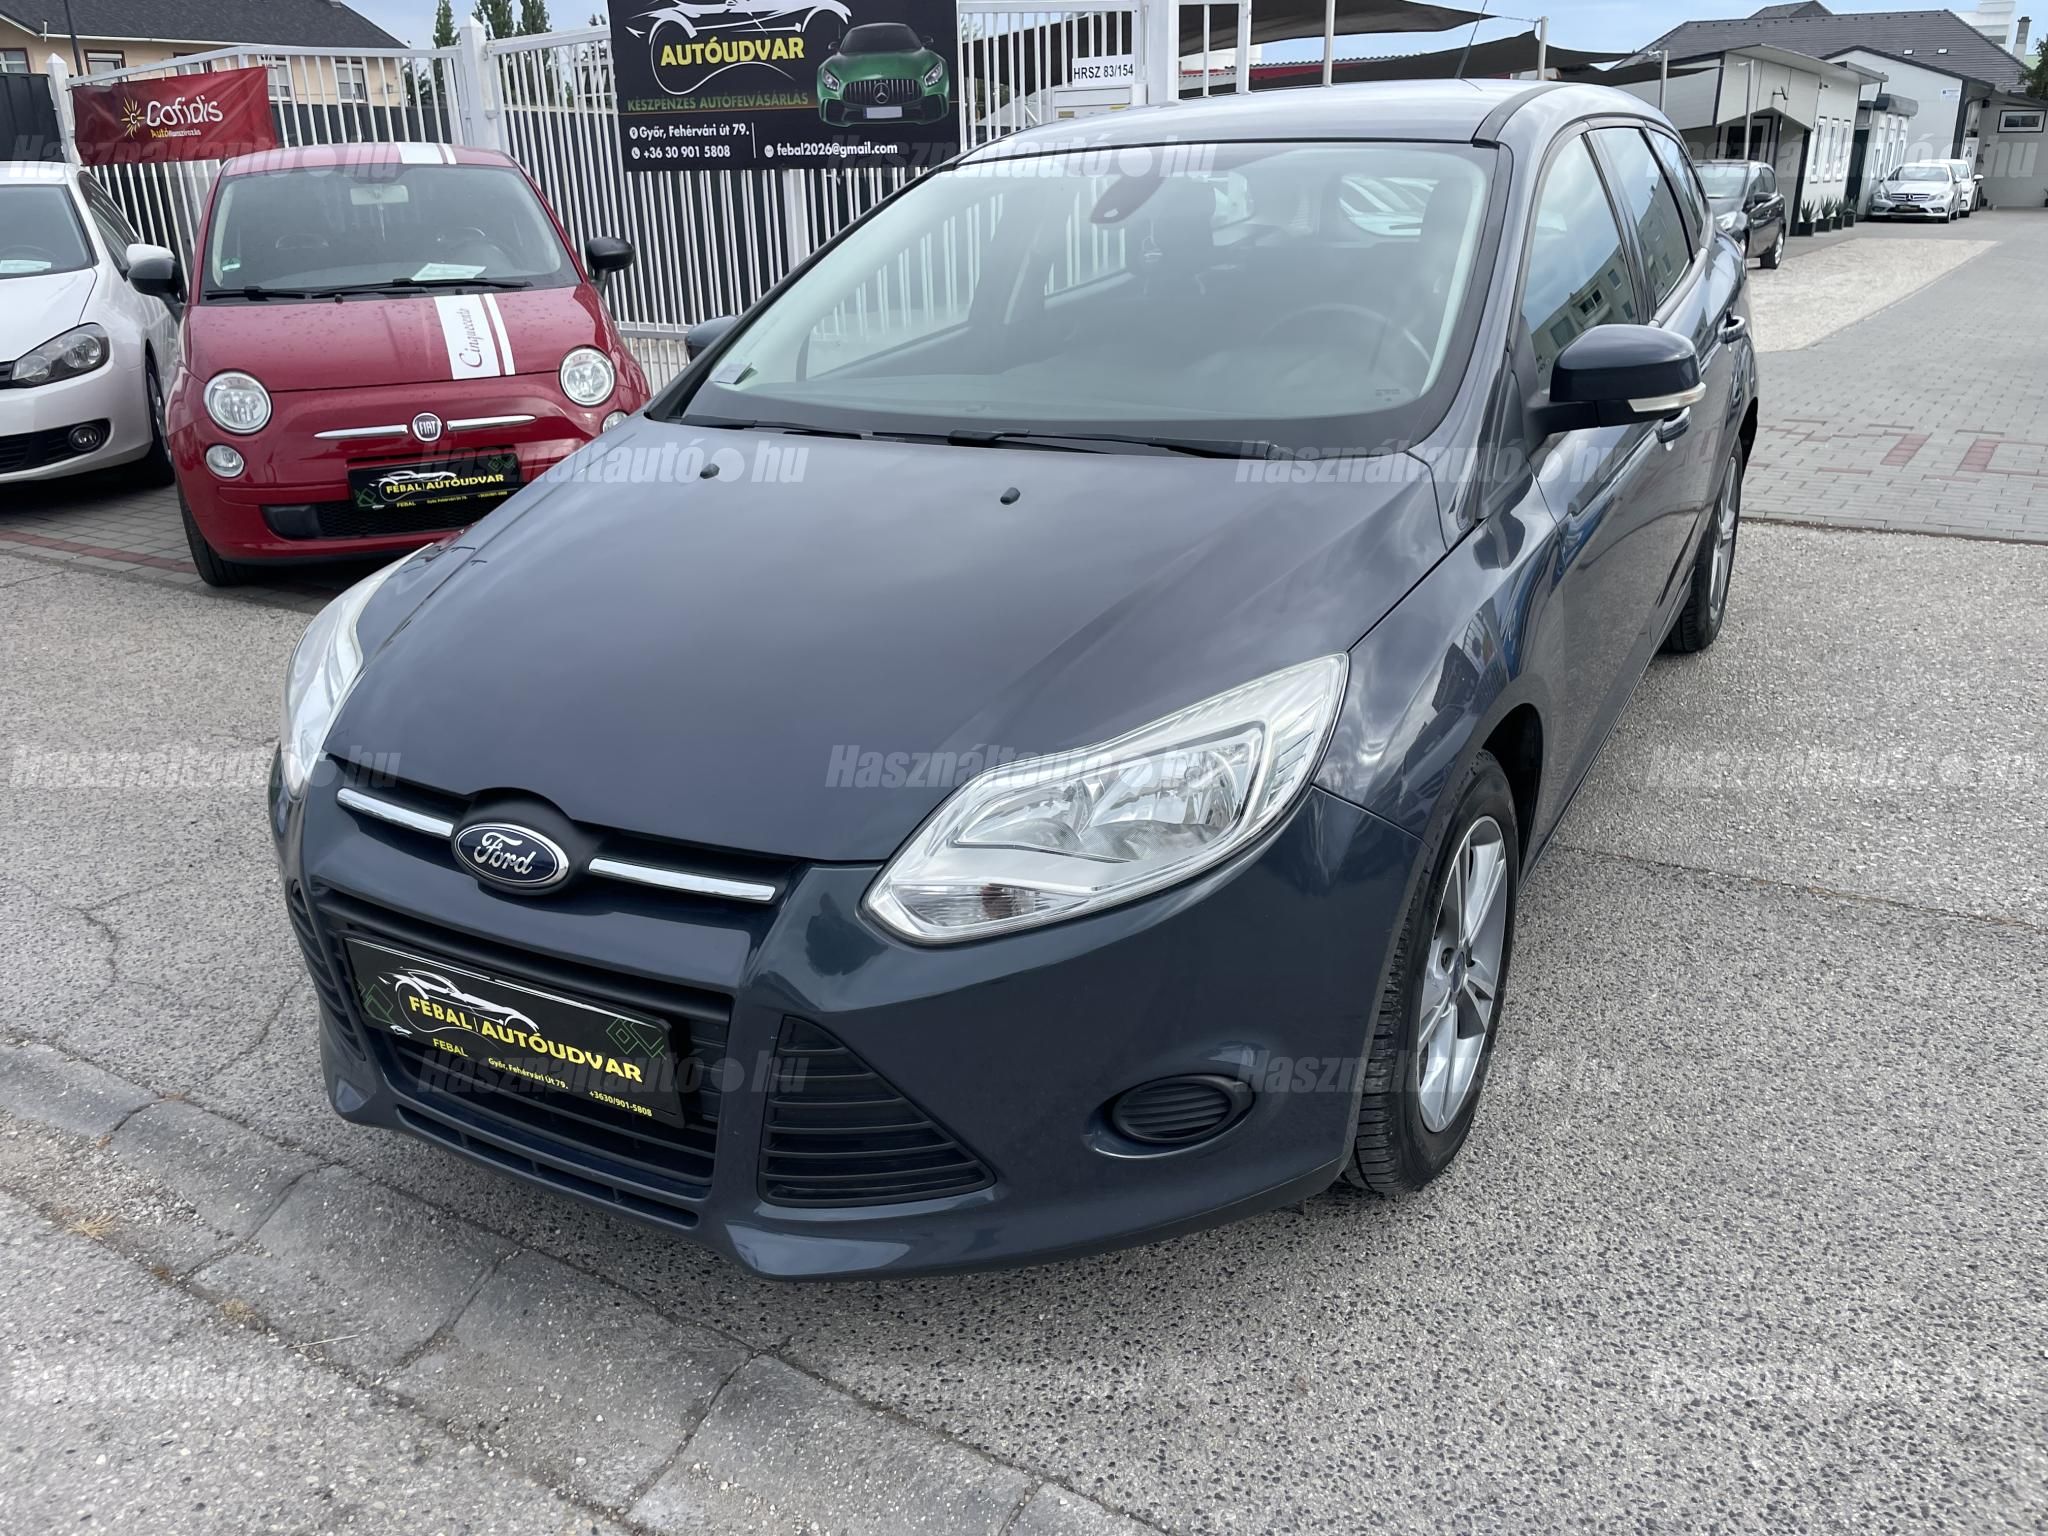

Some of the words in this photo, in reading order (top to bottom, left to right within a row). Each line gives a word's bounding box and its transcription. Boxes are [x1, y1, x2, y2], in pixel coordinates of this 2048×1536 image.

[660, 37, 805, 67] AUTÓUDVAR
[1073, 66, 1101, 79] HRSZ
[1103, 64, 1133, 77] 83/154
[146, 95, 224, 127] Cofidis
[639, 126, 667, 141] Győr,
[669, 123, 716, 137] Fehérvári
[719, 123, 730, 136] út
[732, 123, 750, 135] 79.
[644, 147, 662, 159] +36
[665, 146, 679, 158] 30
[681, 146, 700, 158] 901
[704, 145, 731, 157] 5808
[777, 140, 898, 158] febal2026@gmail.com
[418, 421, 436, 435] FIAT
[386, 483, 423, 494] FEBAL
[473, 831, 536, 875] Ford
[409, 995, 473, 1030] FEBAL
[481, 1020, 643, 1083] AUTÓUDVAR
[433, 1038, 469, 1057] FEBAL
[488, 1057, 508, 1071] Győr,
[509, 1063, 545, 1081] Fehérvári
[555, 1079, 569, 1090] 79.
[589, 1090, 653, 1117] +3630/901-5808
